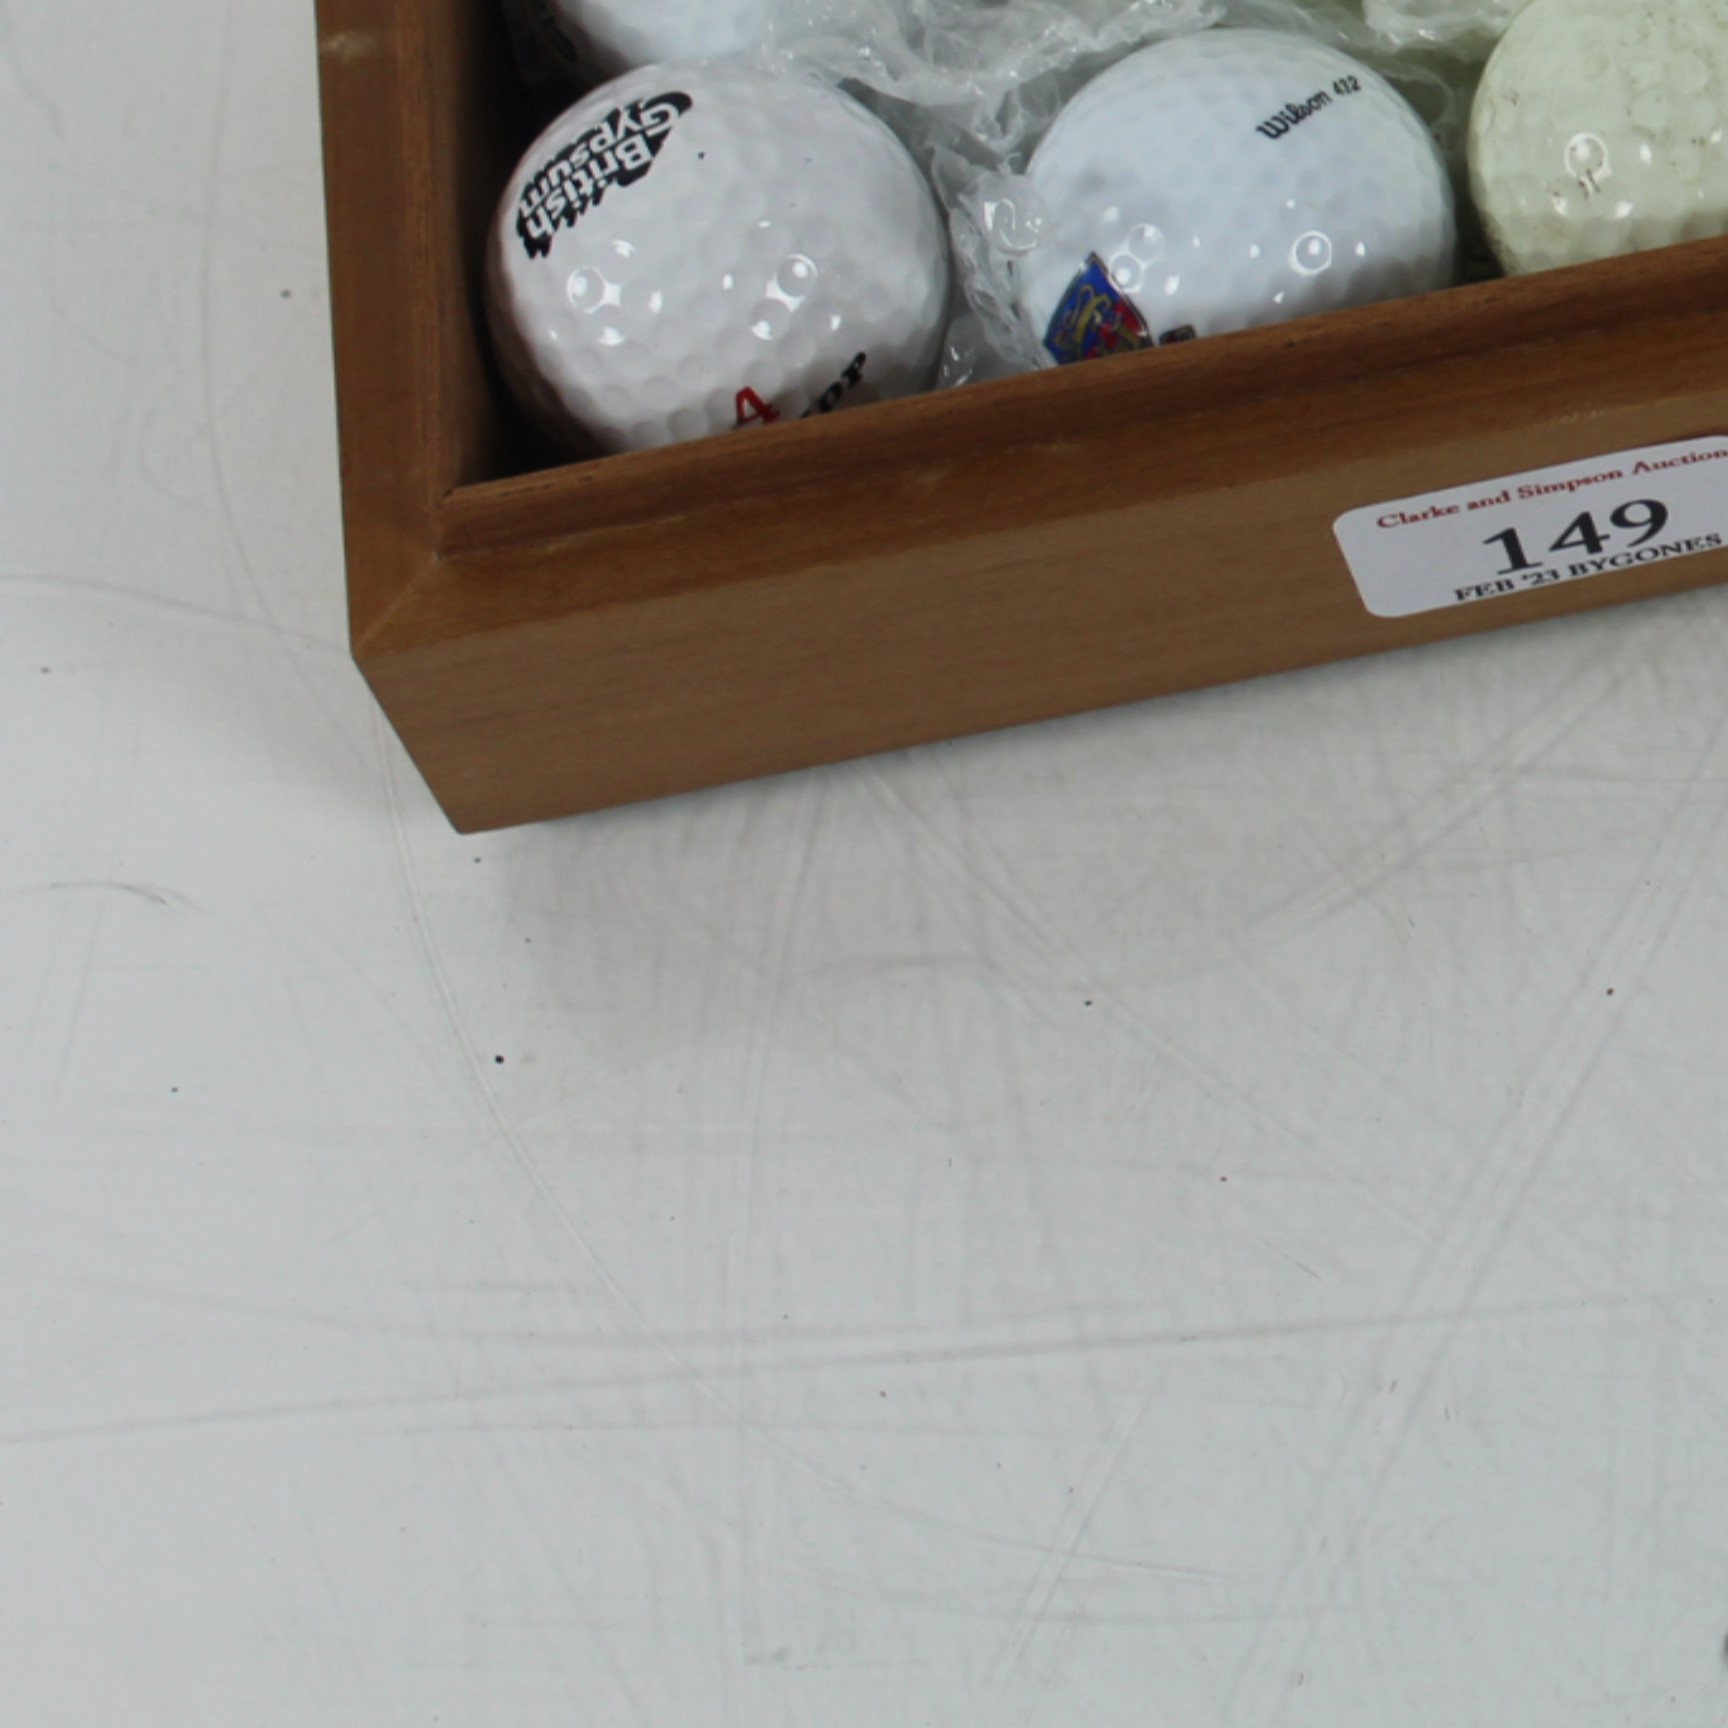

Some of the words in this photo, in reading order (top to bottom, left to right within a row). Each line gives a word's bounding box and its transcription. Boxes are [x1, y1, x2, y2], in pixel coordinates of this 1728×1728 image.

[1256, 89, 1333, 141] Wilson
[517, 100, 681, 215] Gypsum
[523, 132, 654, 242] British
[1376, 504, 1460, 529] Clarke
[1467, 489, 1512, 511] and
[1517, 470, 1623, 500] Simpson
[1454, 578, 1515, 602] FEB
[1568, 532, 1723, 577] BYGONES
[1482, 498, 1669, 576] 149
